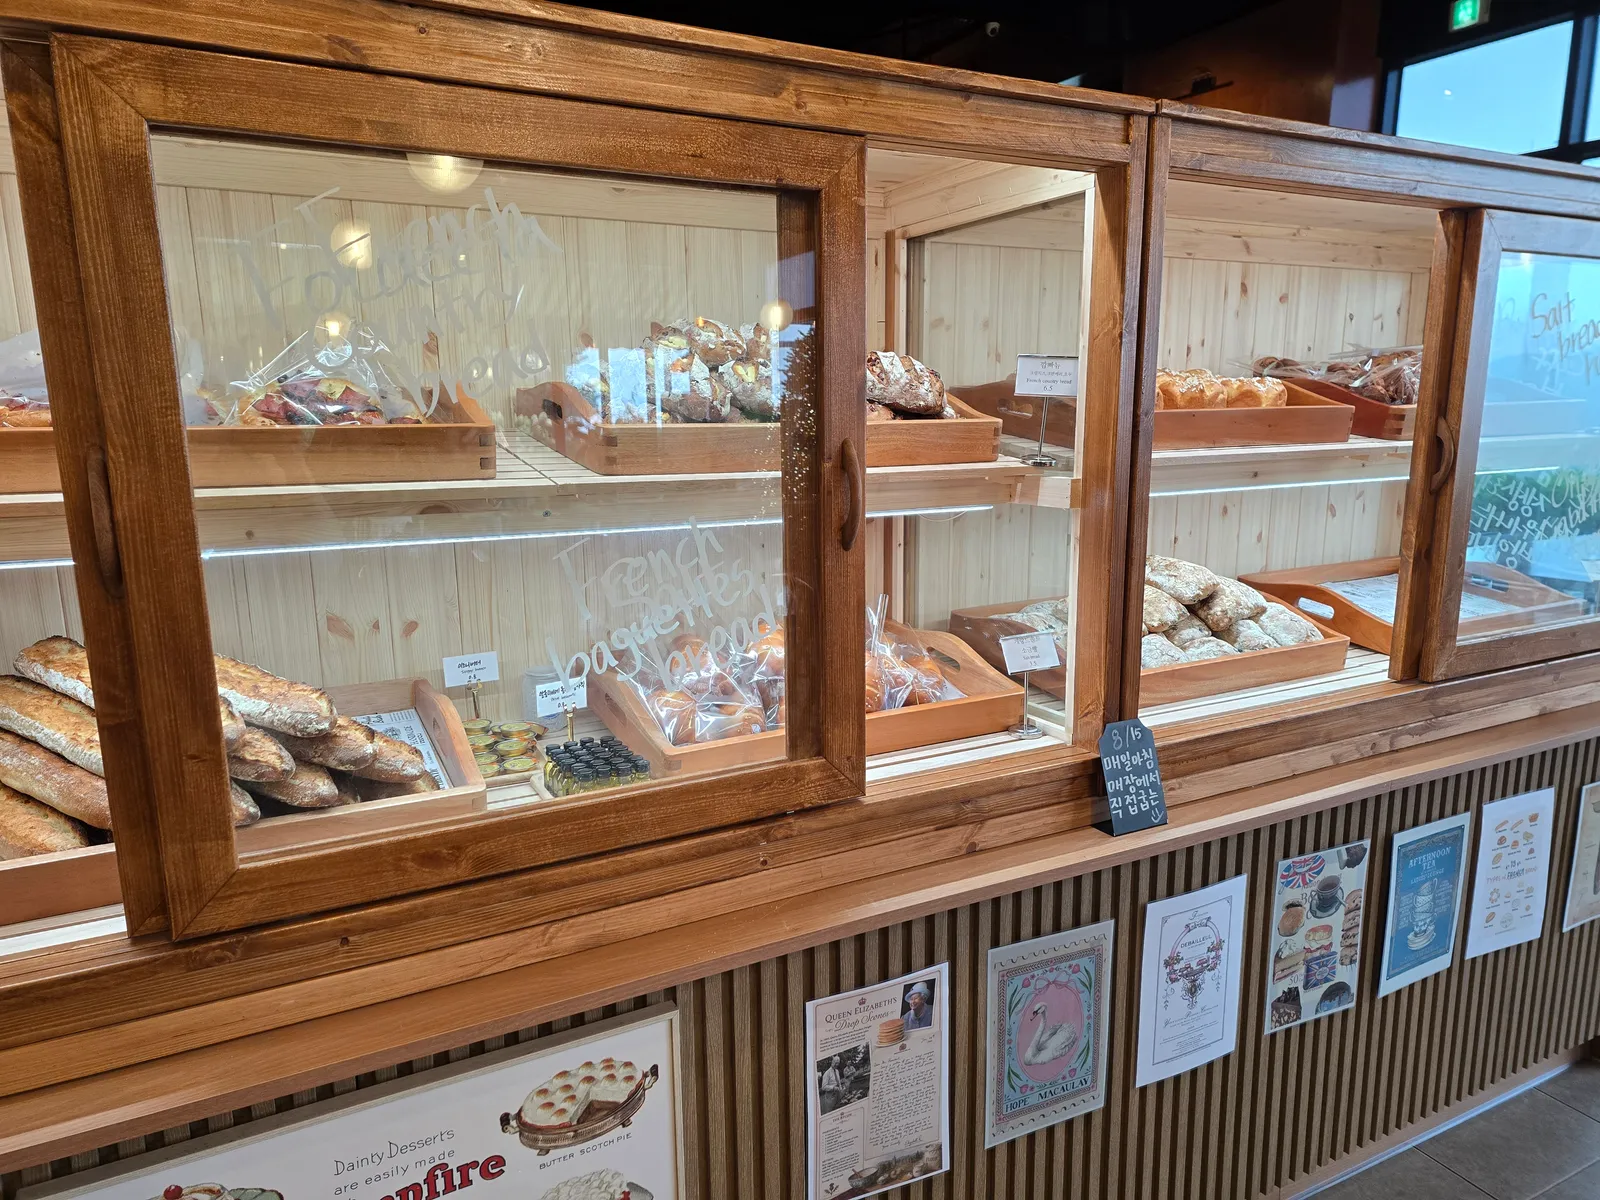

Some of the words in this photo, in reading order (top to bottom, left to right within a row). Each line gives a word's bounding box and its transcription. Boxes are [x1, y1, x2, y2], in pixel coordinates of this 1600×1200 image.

[1530, 292, 1576, 339] Salt
[650, 583, 783, 692] bread
[1111, 725, 1142, 750] 8/15
[1107, 770, 1161, 793] 매장에서
[1408, 845, 1451, 869] AFTERNOON
[1422, 861, 1436, 871] TEA
[824, 1009, 852, 1025] QUEEN
[854, 996, 898, 1015] ELIZABETH'S
[834, 1017, 860, 1033] Drop
[861, 1010, 891, 1028] Scones
[1005, 1096, 1030, 1113] HOPE
[1037, 1076, 1090, 1102] MACAULAY
[333, 1151, 385, 1176] Dainty
[387, 1128, 455, 1160] Desserts
[539, 1152, 575, 1170] BUTTER
[580, 1140, 615, 1156] SCOTCH
[616, 1132, 632, 1143] PIE
[334, 1180, 359, 1196] are
[364, 1163, 410, 1187] easily
[414, 1148, 455, 1169] made
